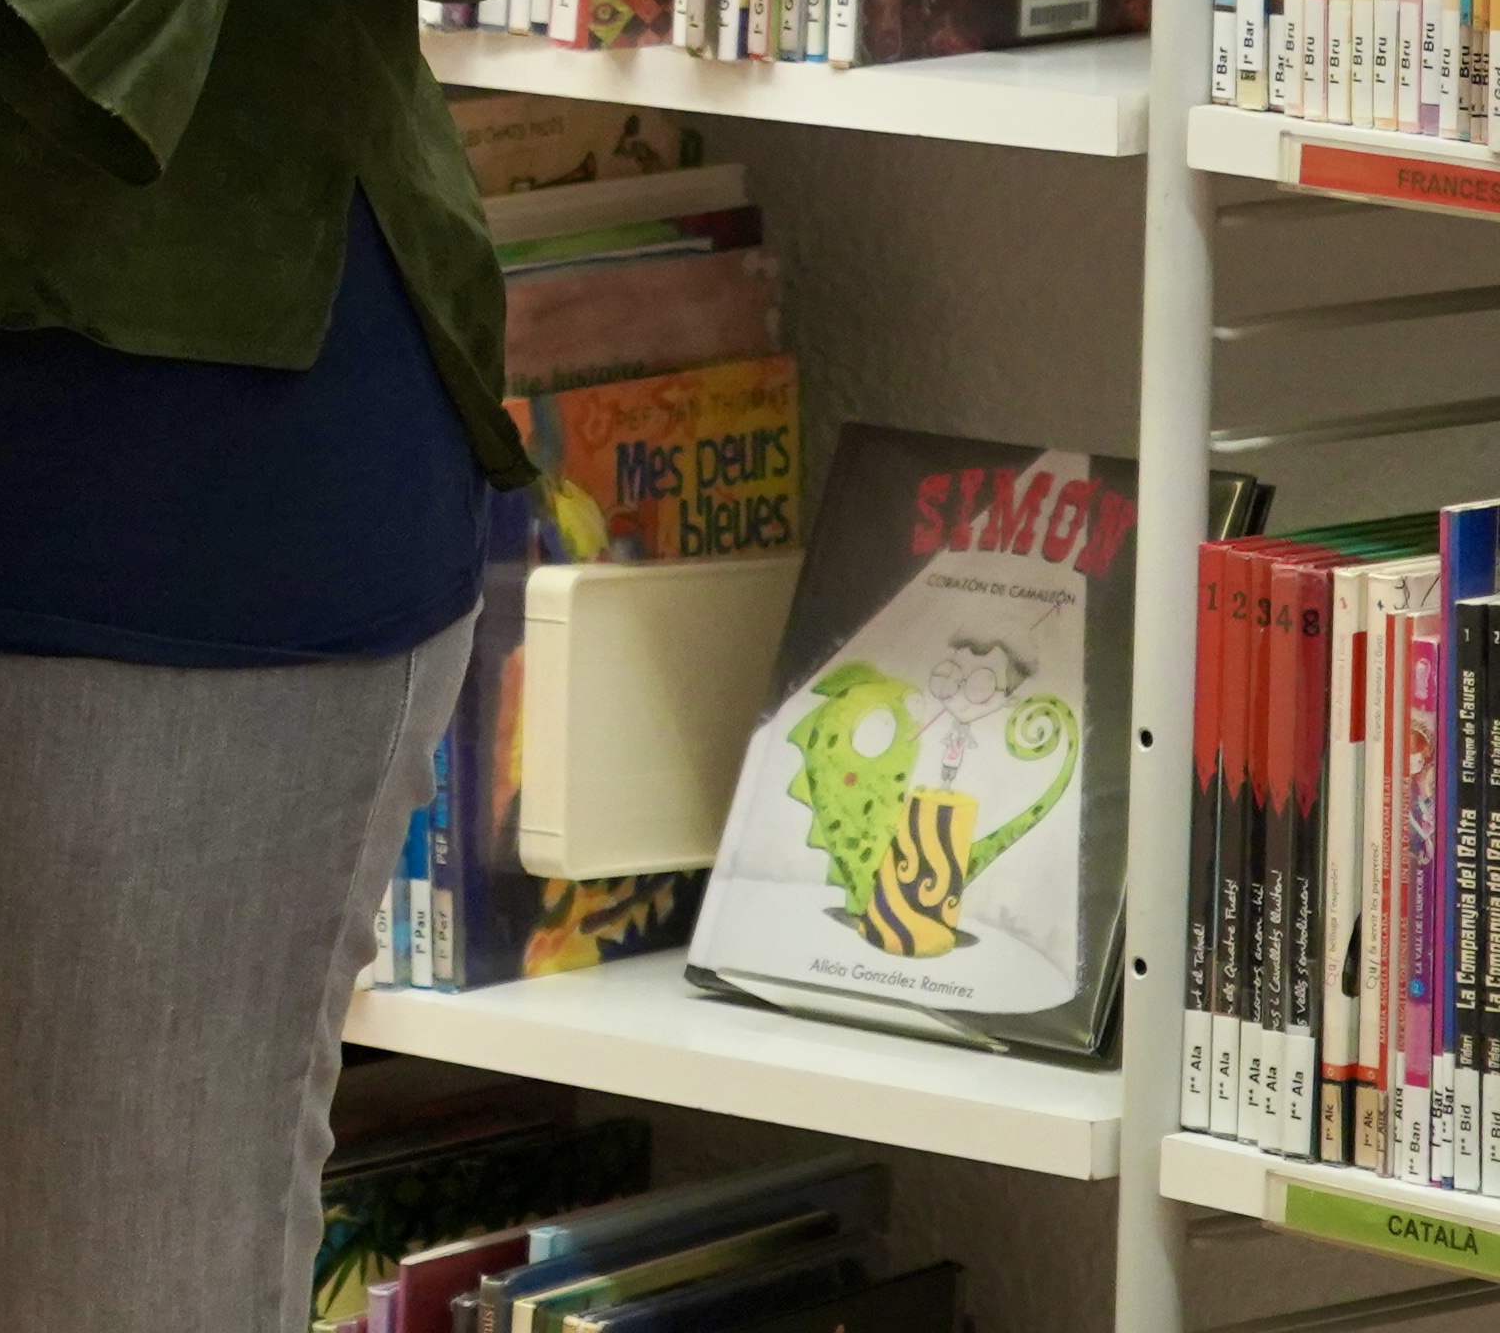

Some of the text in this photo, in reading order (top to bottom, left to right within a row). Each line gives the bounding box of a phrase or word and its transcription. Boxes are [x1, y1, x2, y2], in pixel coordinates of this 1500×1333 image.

[616, 423, 791, 507] Mes peurs
[680, 495, 791, 560] bleues
[927, 573, 1076, 608] CORAZÓN CAMALEÓN
[1207, 583, 1217, 611] 1
[1233, 591, 1247, 619] 2
[1257, 597, 1272, 627] 3
[1275, 604, 1292, 633] 4
[1303, 609, 1320, 637] 8
[1455, 863, 1478, 1009] La Companyia del
[809, 957, 917, 990] Alicia González
[1387, 1215, 1479, 1255] CATALÀ
